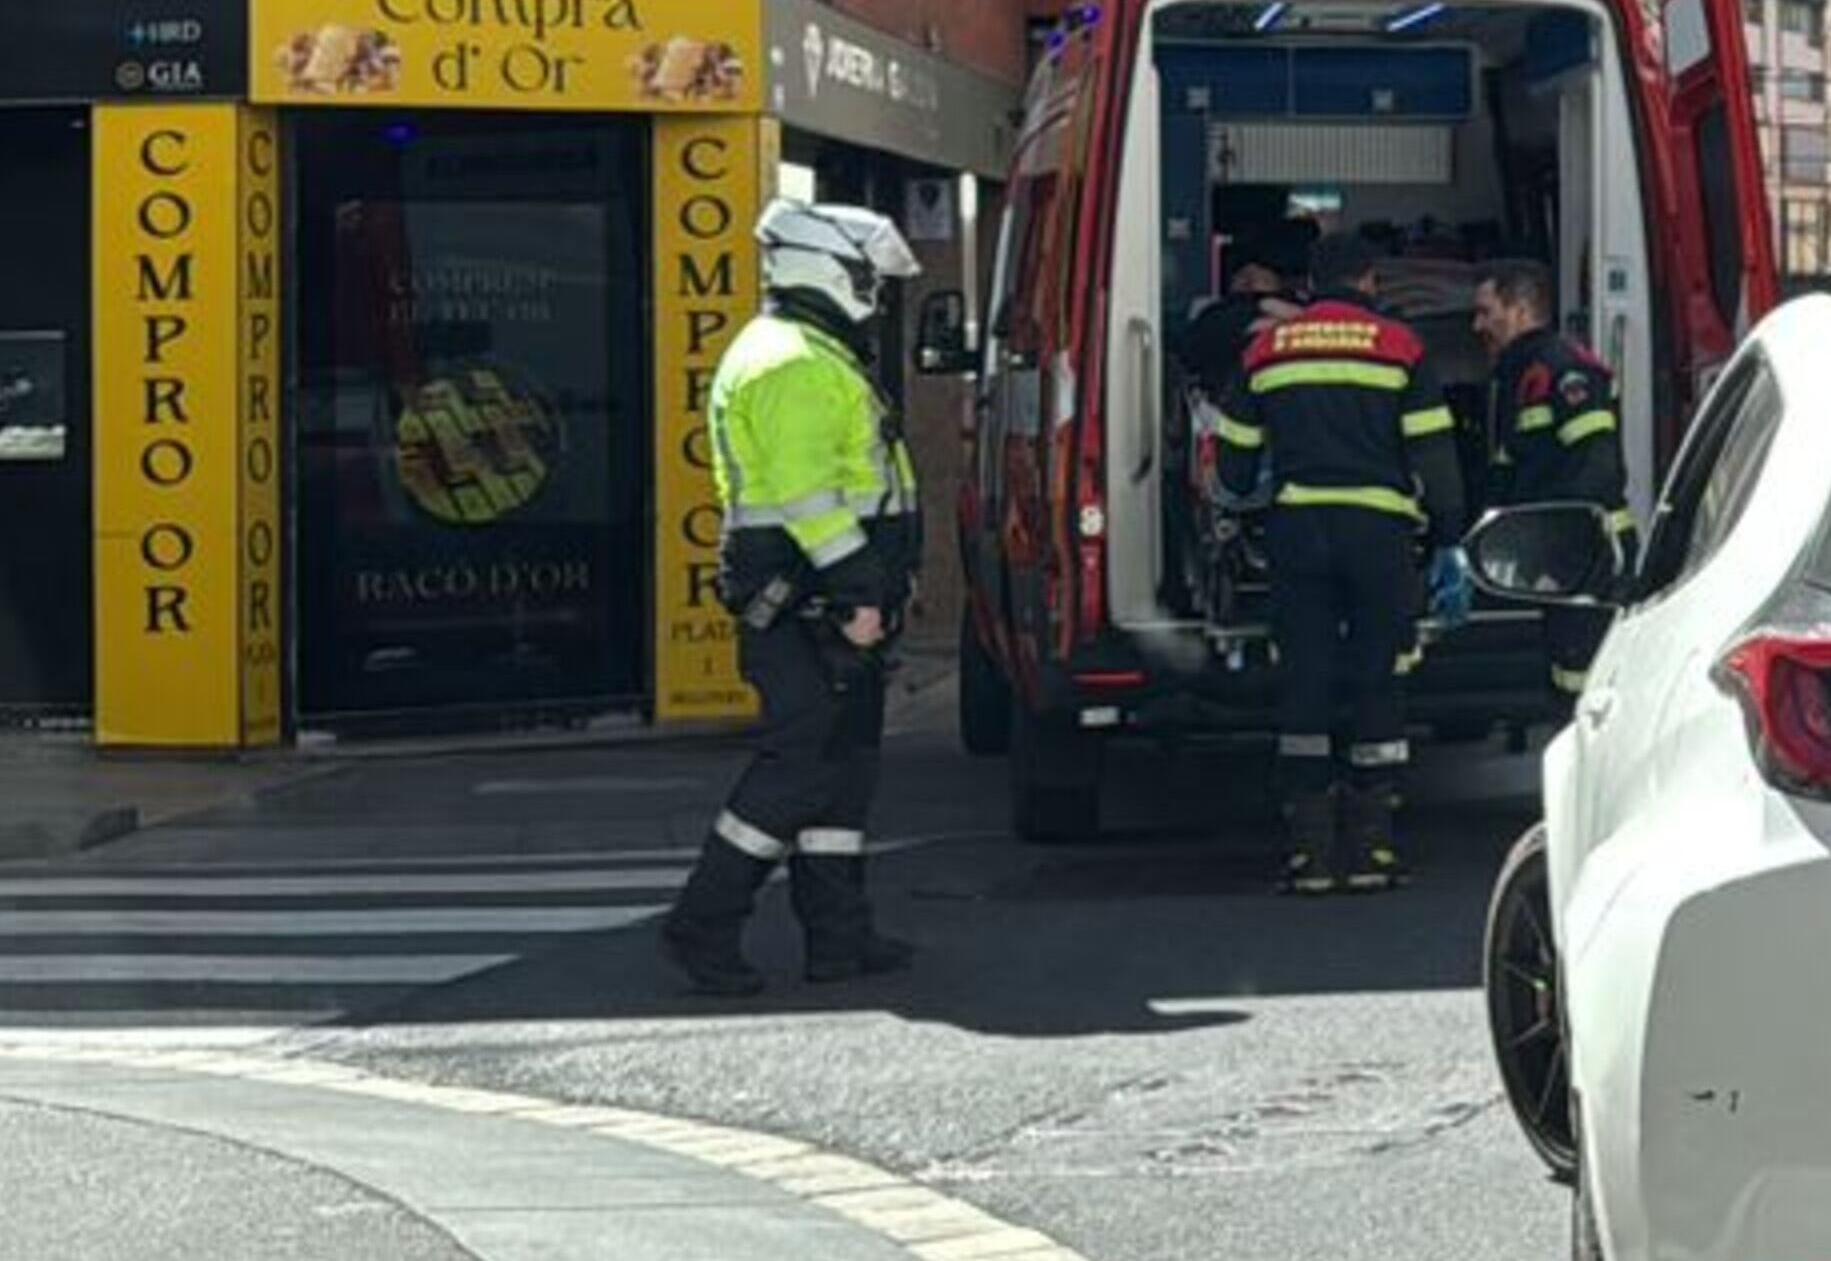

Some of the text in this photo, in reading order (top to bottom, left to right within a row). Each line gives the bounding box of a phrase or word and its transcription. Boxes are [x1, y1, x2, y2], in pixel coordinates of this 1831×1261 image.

[147, 61, 203, 87] GIA
[502, 45, 586, 93] Or
[247, 129, 273, 484] COMPRO
[135, 129, 193, 633] COMPRO OR
[247, 520, 273, 631] OR
